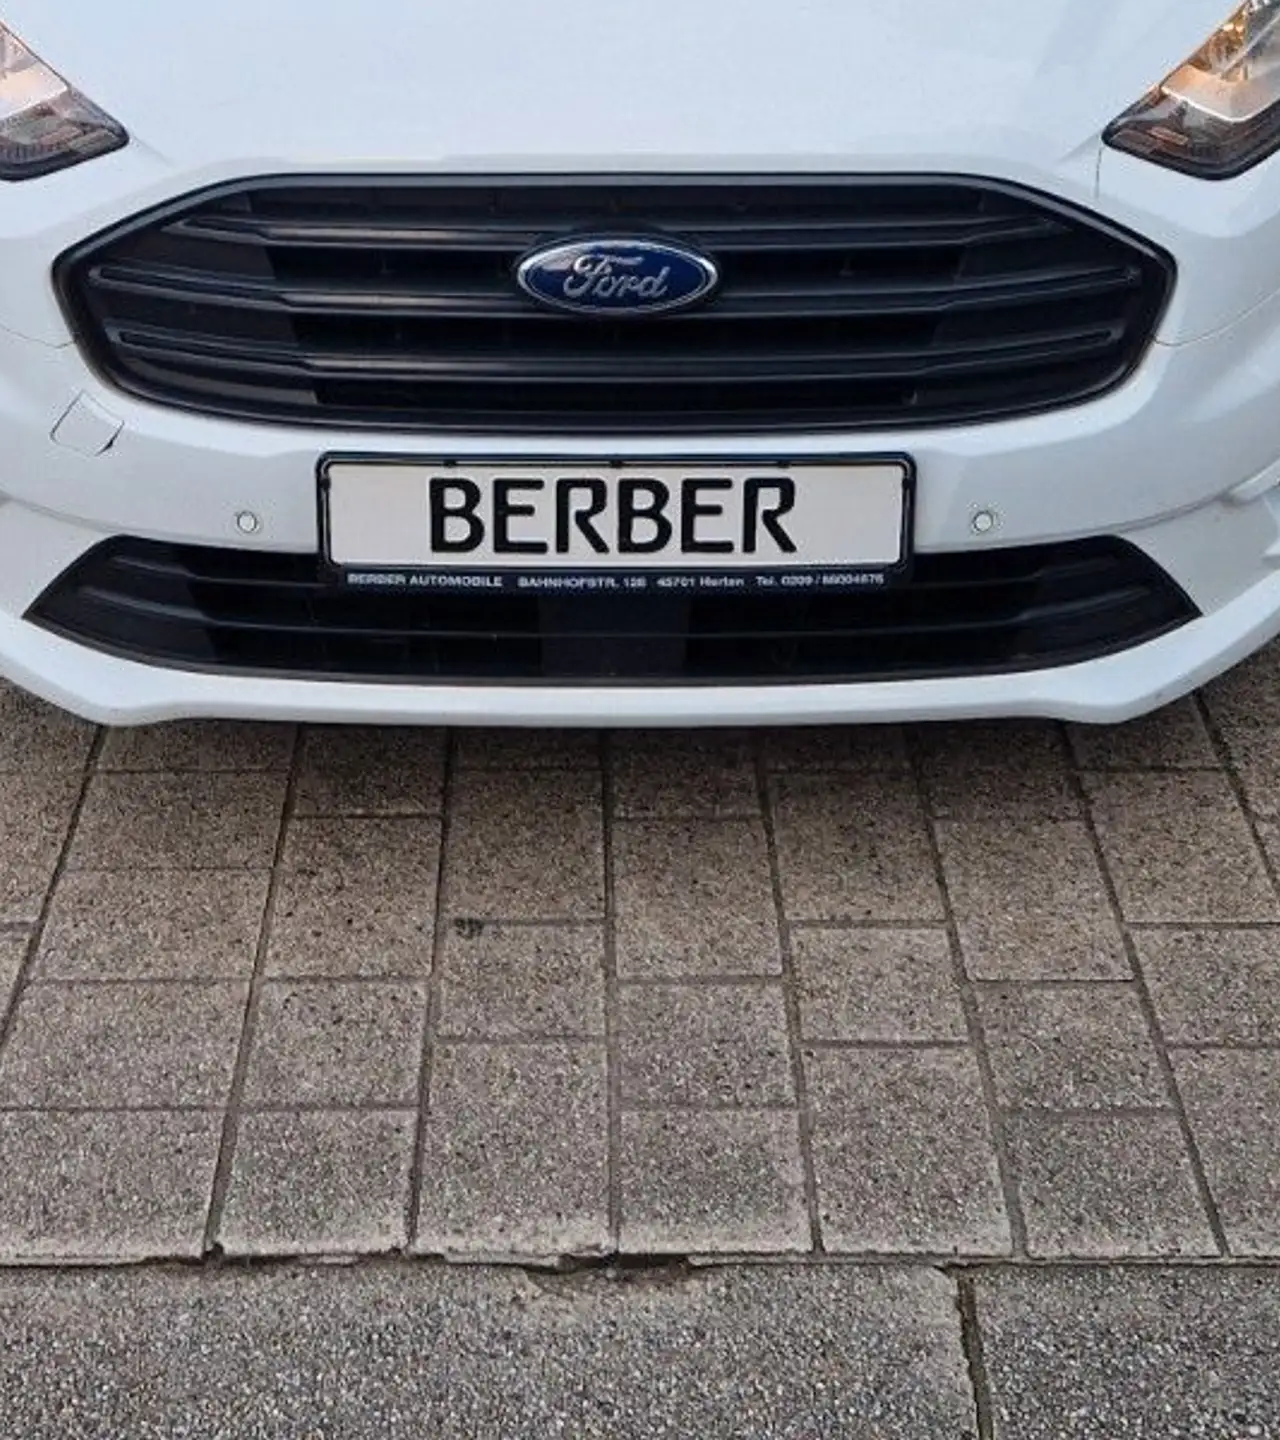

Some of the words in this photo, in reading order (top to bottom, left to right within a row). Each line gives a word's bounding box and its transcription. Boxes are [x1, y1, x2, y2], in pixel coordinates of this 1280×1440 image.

[563, 254, 671, 298] Ford
[429, 477, 798, 555] BERBER
[347, 573, 407, 585] BERBER
[409, 575, 503, 587] AUTOMOBILE
[517, 576, 618, 588] BAHNHOFSTR.
